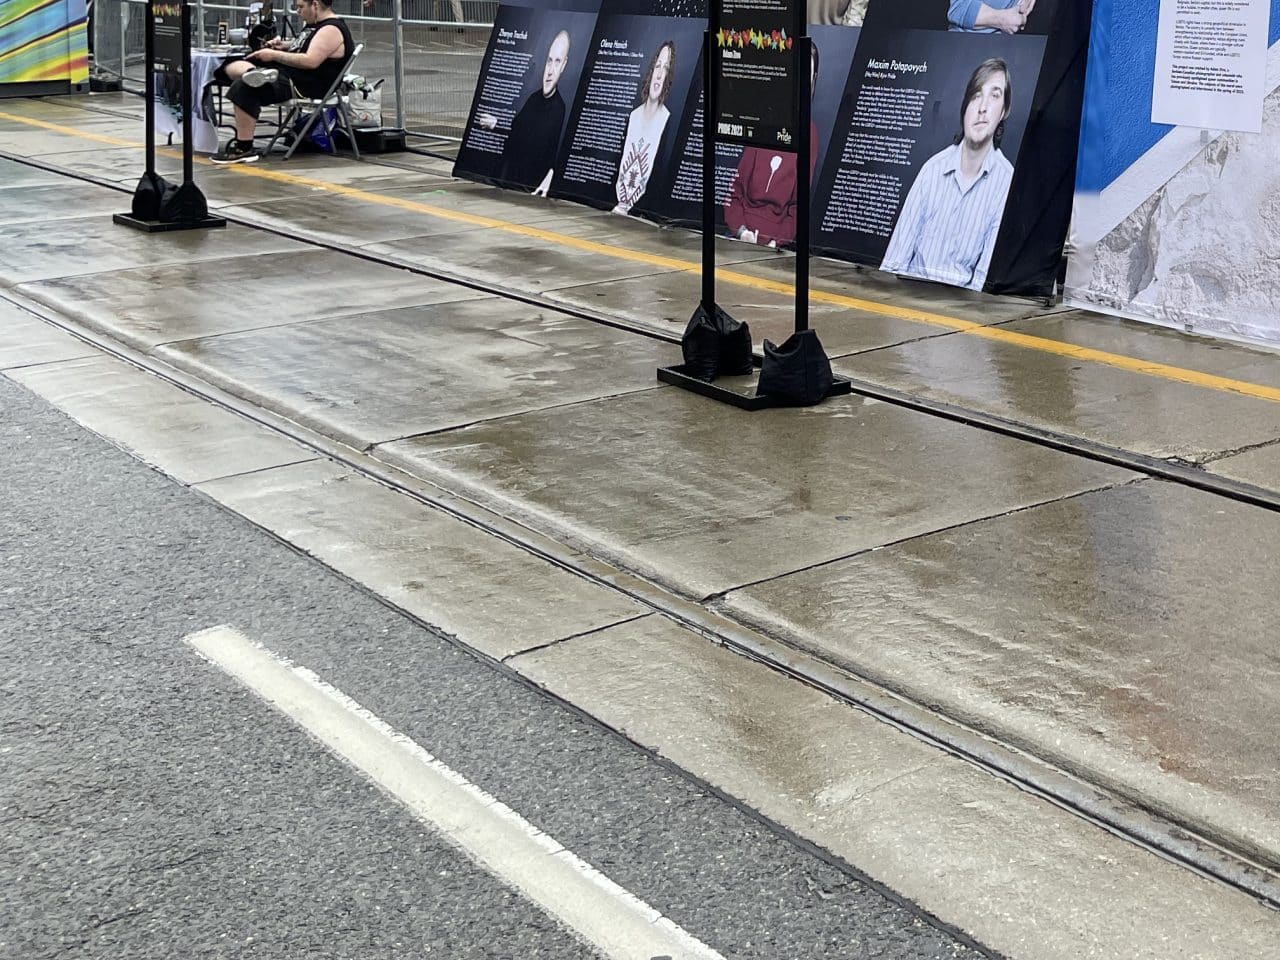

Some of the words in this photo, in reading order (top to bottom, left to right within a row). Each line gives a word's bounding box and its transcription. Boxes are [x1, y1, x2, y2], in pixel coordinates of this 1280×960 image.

[867, 58, 890, 70] Maxim
[890, 59, 928, 75] Potapovych
[777, 131, 792, 143] Pride
